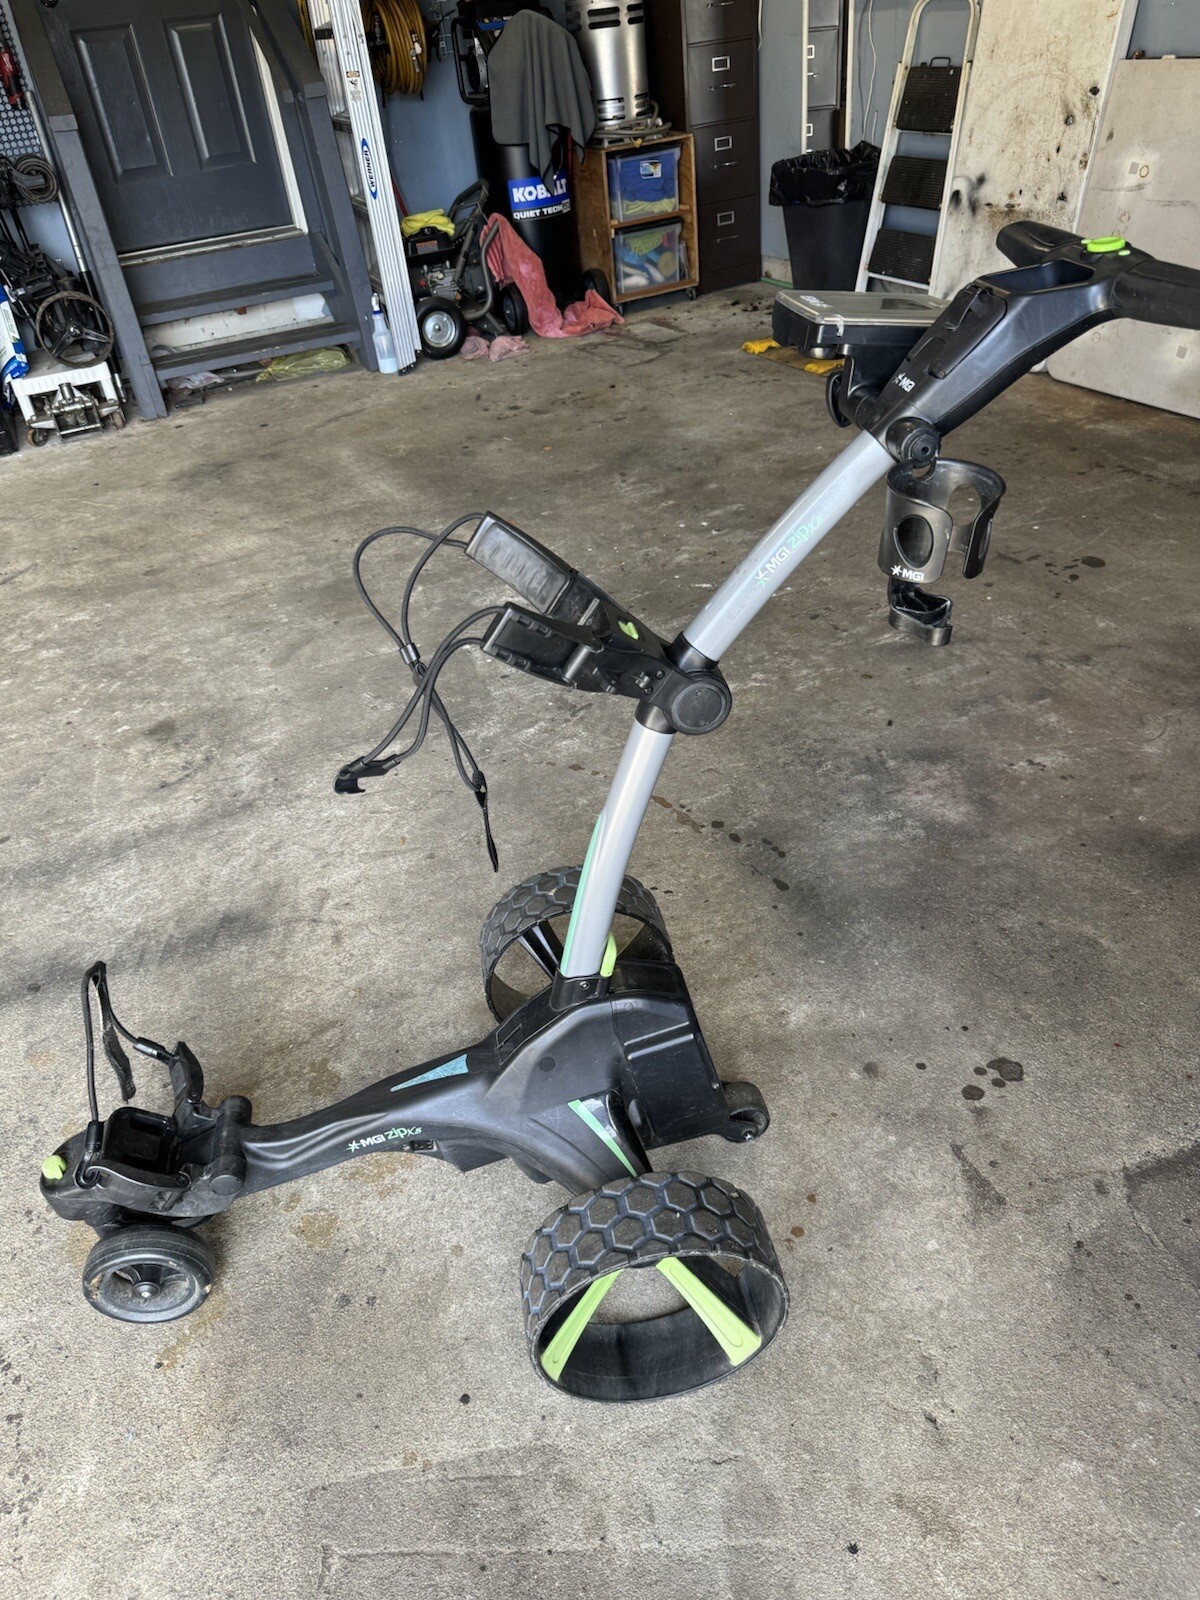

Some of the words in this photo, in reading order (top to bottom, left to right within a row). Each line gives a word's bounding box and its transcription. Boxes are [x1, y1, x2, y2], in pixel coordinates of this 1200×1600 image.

[364, 150, 375, 188] WERNER
[513, 209, 541, 220] QUIET
[542, 203, 563, 216] TECH
[899, 376, 915, 392] MGI
[765, 546, 791, 574] MGI
[902, 568, 925, 581] MGI
[360, 1133, 387, 1148] MGI
